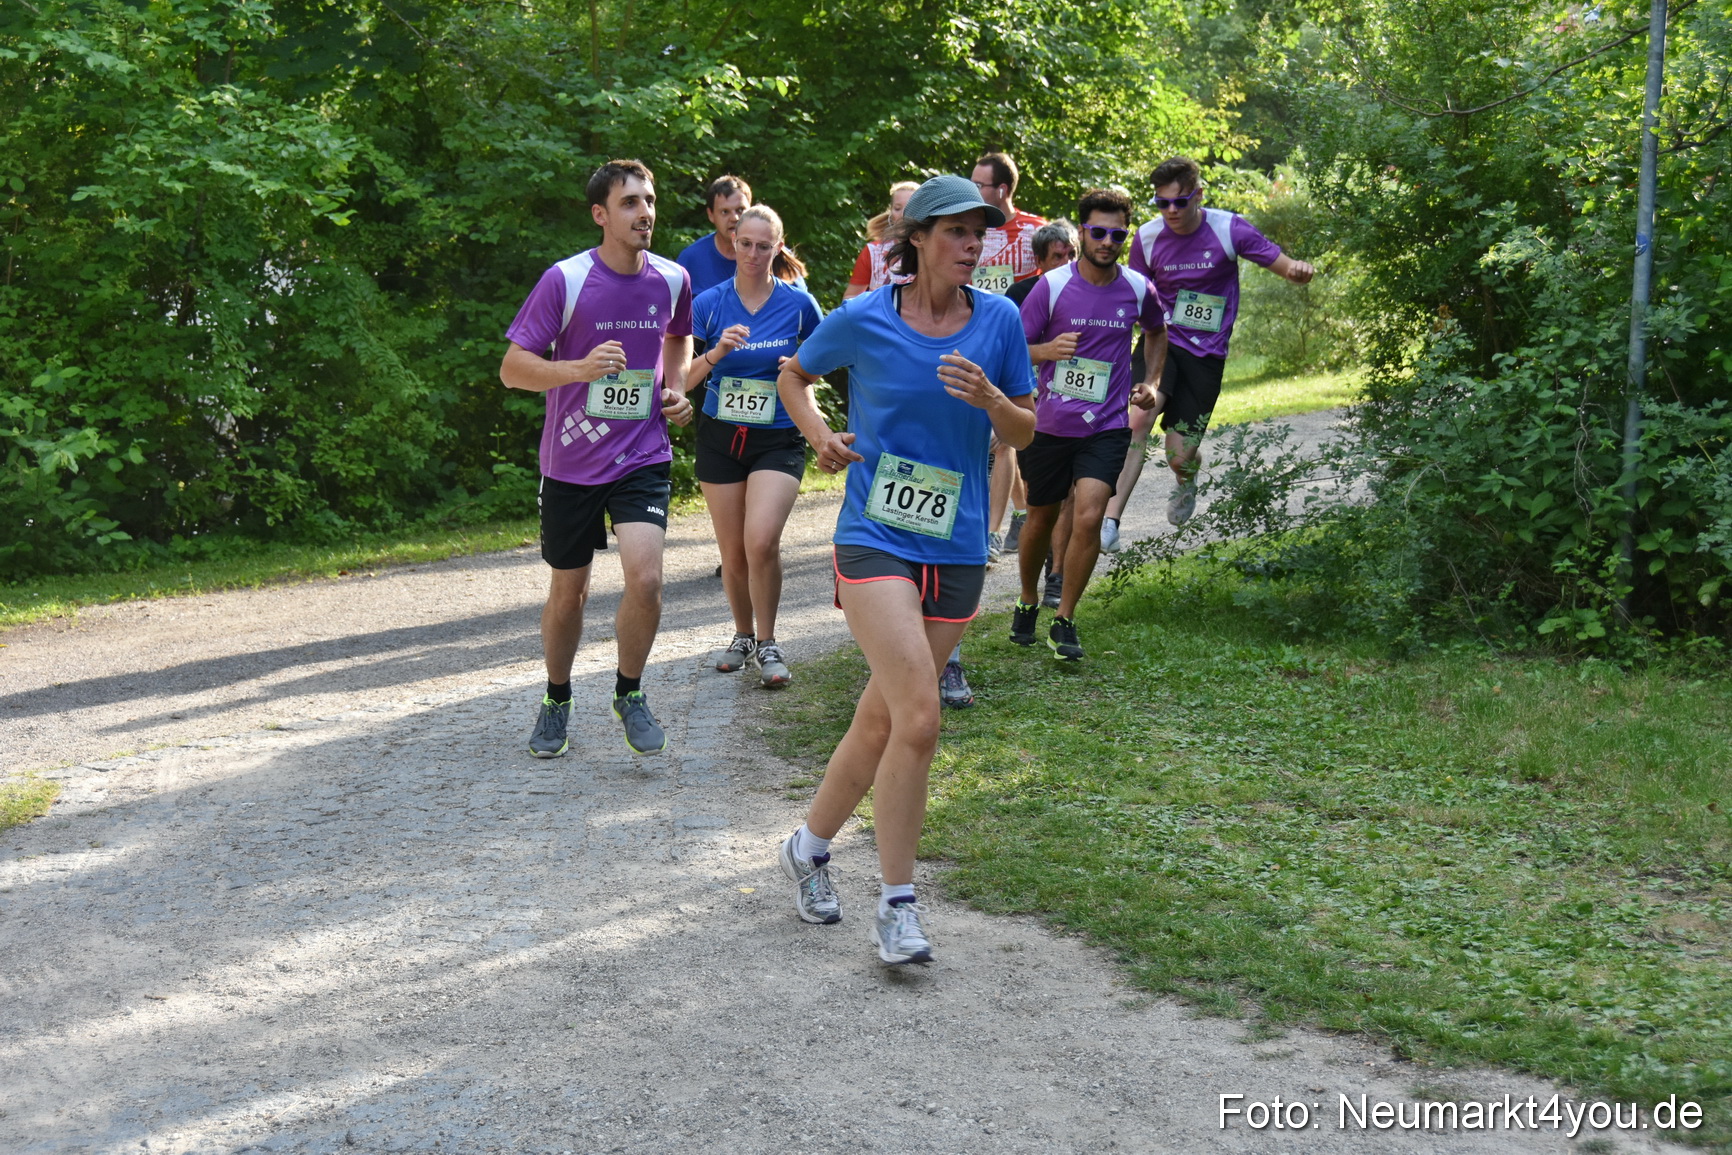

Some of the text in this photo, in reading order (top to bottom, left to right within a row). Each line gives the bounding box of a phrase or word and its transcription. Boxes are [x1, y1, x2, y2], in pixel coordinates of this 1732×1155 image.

[977, 277, 1008, 289] 2218
[1185, 304, 1212, 320] 883
[595, 321, 660, 330] WIR SIND LILA.
[1070, 318, 1127, 329] WIR SIND LILA.
[1065, 371, 1095, 390] 881
[603, 387, 640, 406] 905
[725, 393, 768, 411] 2157
[883, 481, 947, 518] 1078
[647, 506, 664, 516] JAKO
[882, 505, 939, 525] Lastinger Kerstin
